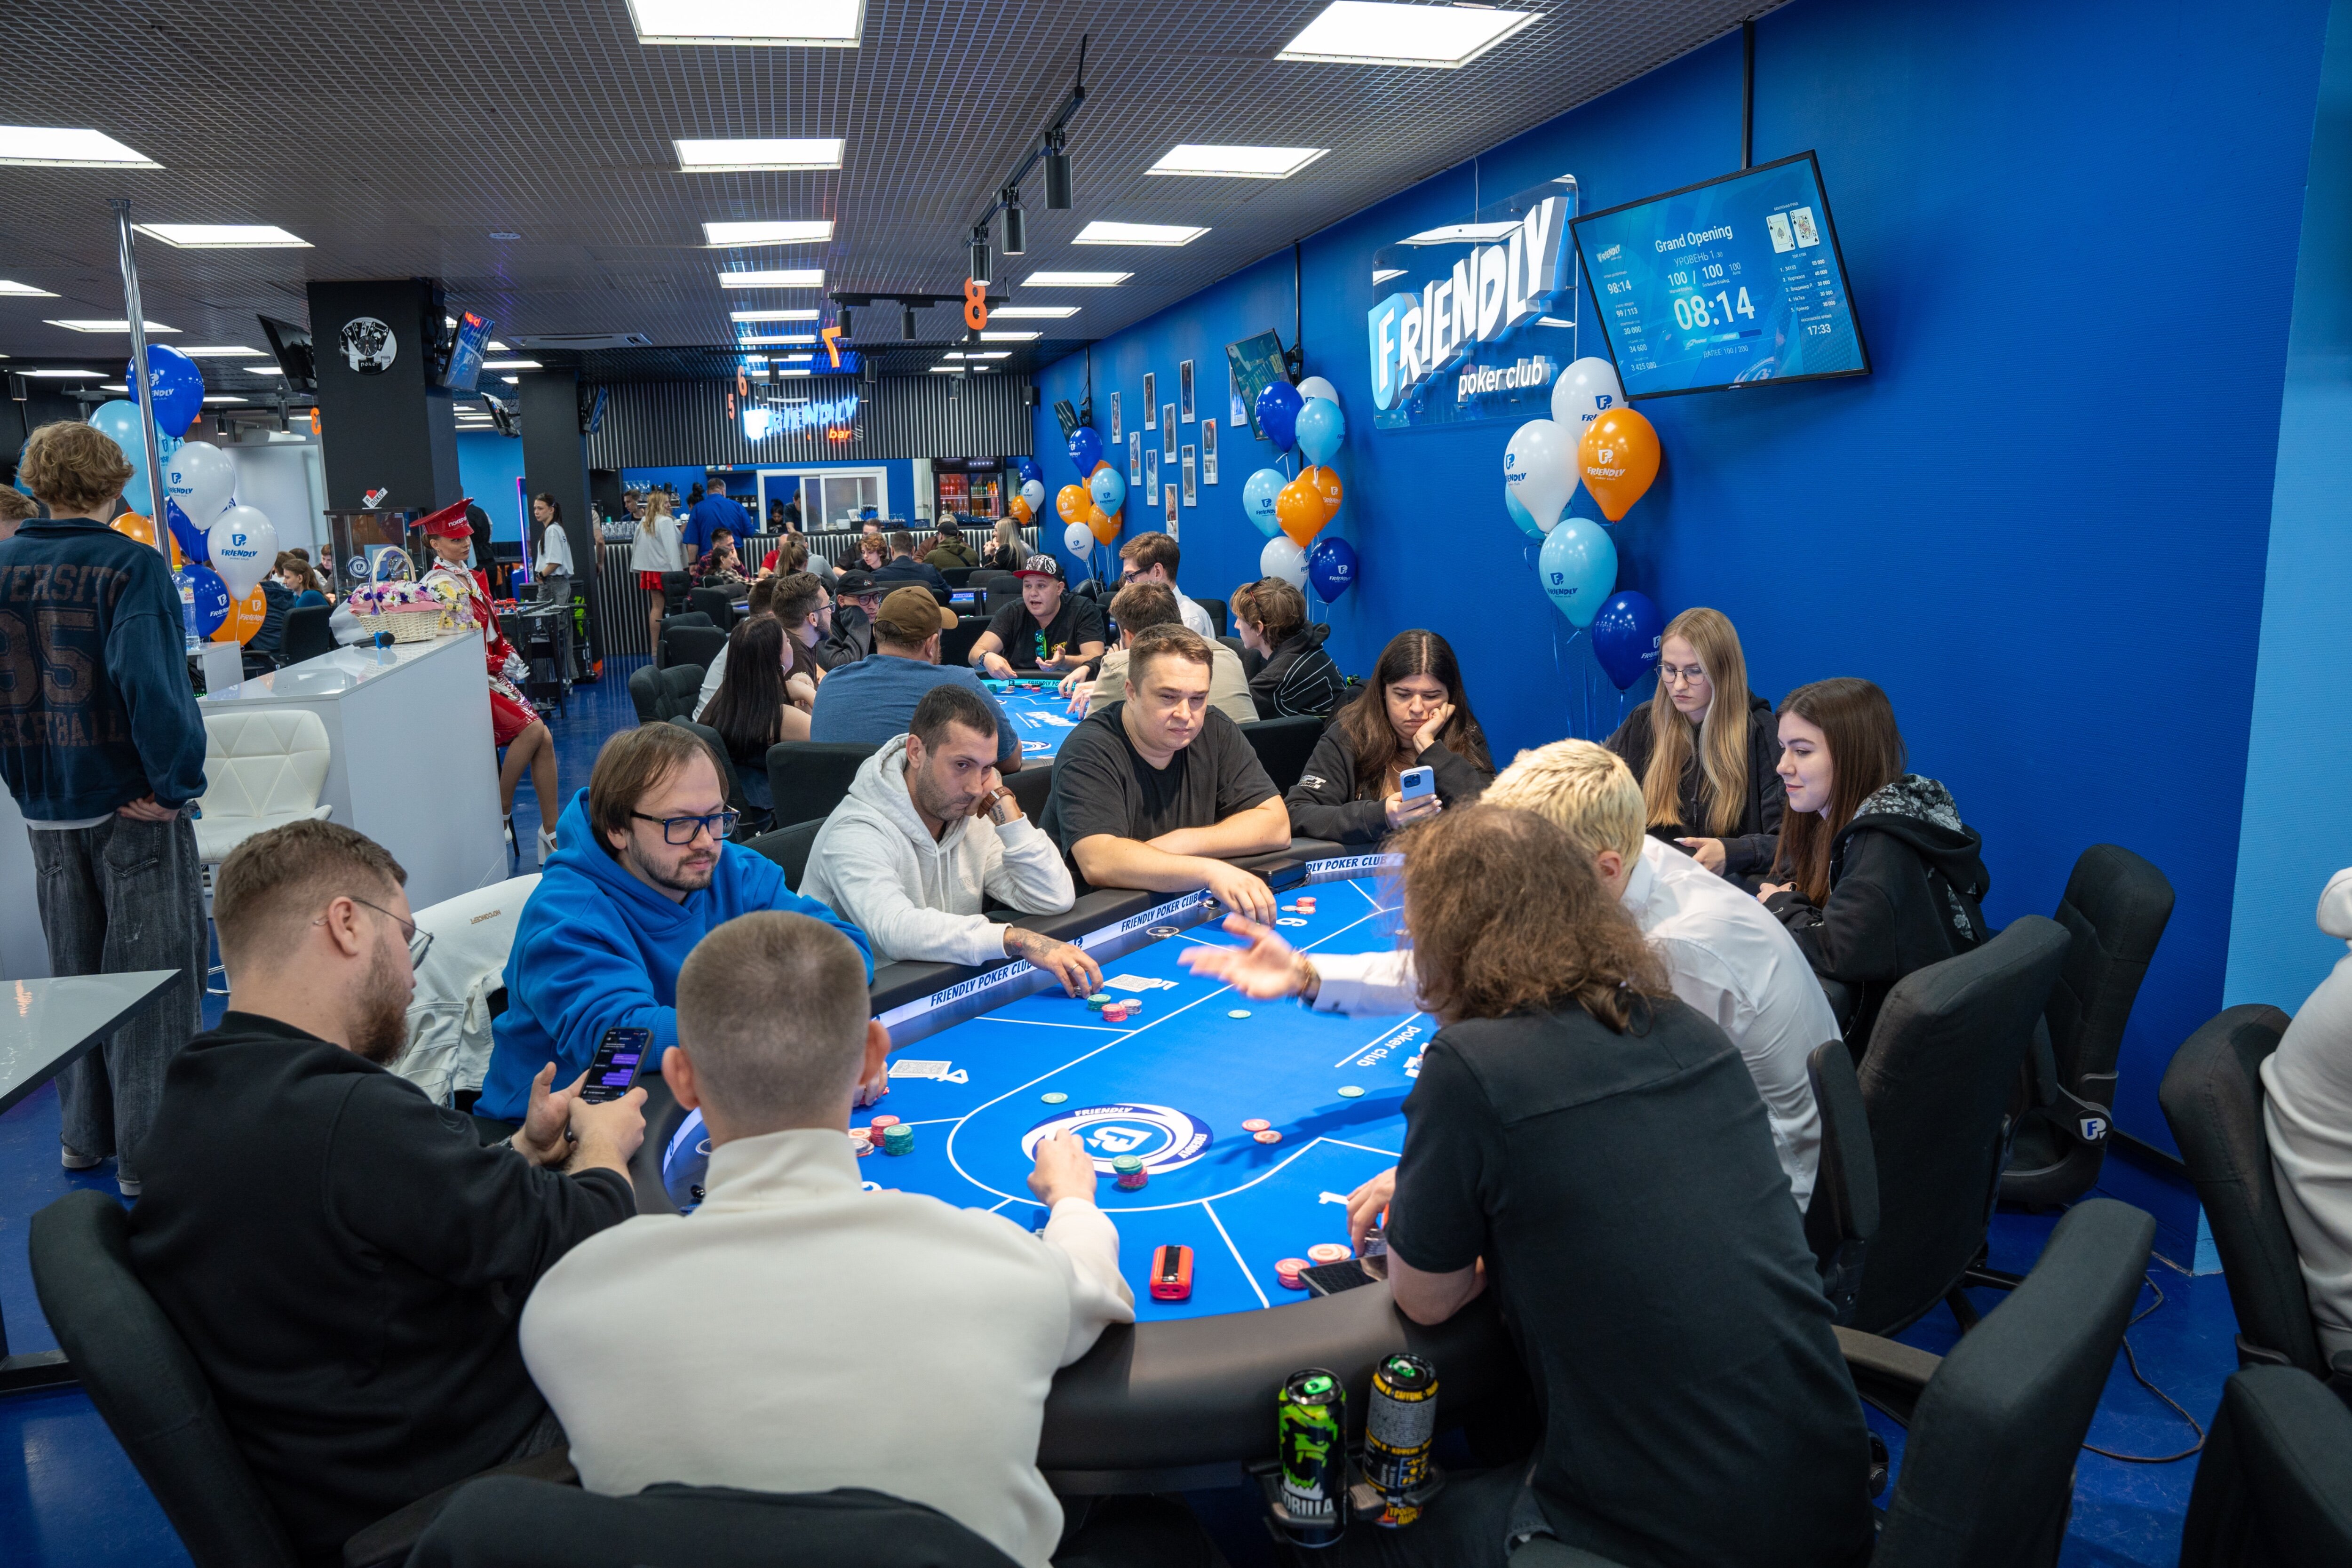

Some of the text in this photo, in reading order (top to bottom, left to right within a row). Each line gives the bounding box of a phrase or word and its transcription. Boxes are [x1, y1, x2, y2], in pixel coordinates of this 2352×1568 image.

[1655, 225, 1733, 253] Grand Opening
[1597, 244, 1620, 262] FRIENDLY
[1674, 252, 1708, 267] УРОВЕНЬ
[1709, 250, 1715, 259] 1
[1668, 271, 1688, 286] 100
[1702, 263, 1723, 279] 100
[1729, 262, 1741, 271] 100
[1379, 196, 1556, 394] FRIENDLY
[1607, 279, 1631, 294] 98:14
[964, 276, 987, 330] 8
[1674, 287, 1755, 330] 08:14
[1807, 324, 1831, 335] 17:33
[1703, 350, 1723, 358] ДАЛЕЕ:
[738, 365, 747, 396] 6
[1458, 359, 1542, 398] poker club
[728, 394, 735, 420] 5
[753, 397, 858, 435] RIENDLY
[829, 429, 850, 439] bar
[1587, 467, 1626, 477] FRIENDLY
[370, 490, 385, 507] ПОКЕР
[1325, 858, 1358, 870] POKER
[1362, 856, 1386, 866] CLUB
[1121, 893, 1198, 932] FRIENDLY POKER CLUB
[930, 959, 1032, 1007] FRIENDLY POKER CLUB
[1384, 1026, 1422, 1050] poker
[1357, 1048, 1388, 1067] club
[1074, 1107, 1134, 1117] FRIENDLY
[1177, 1133, 1208, 1159] FRIENDLY
